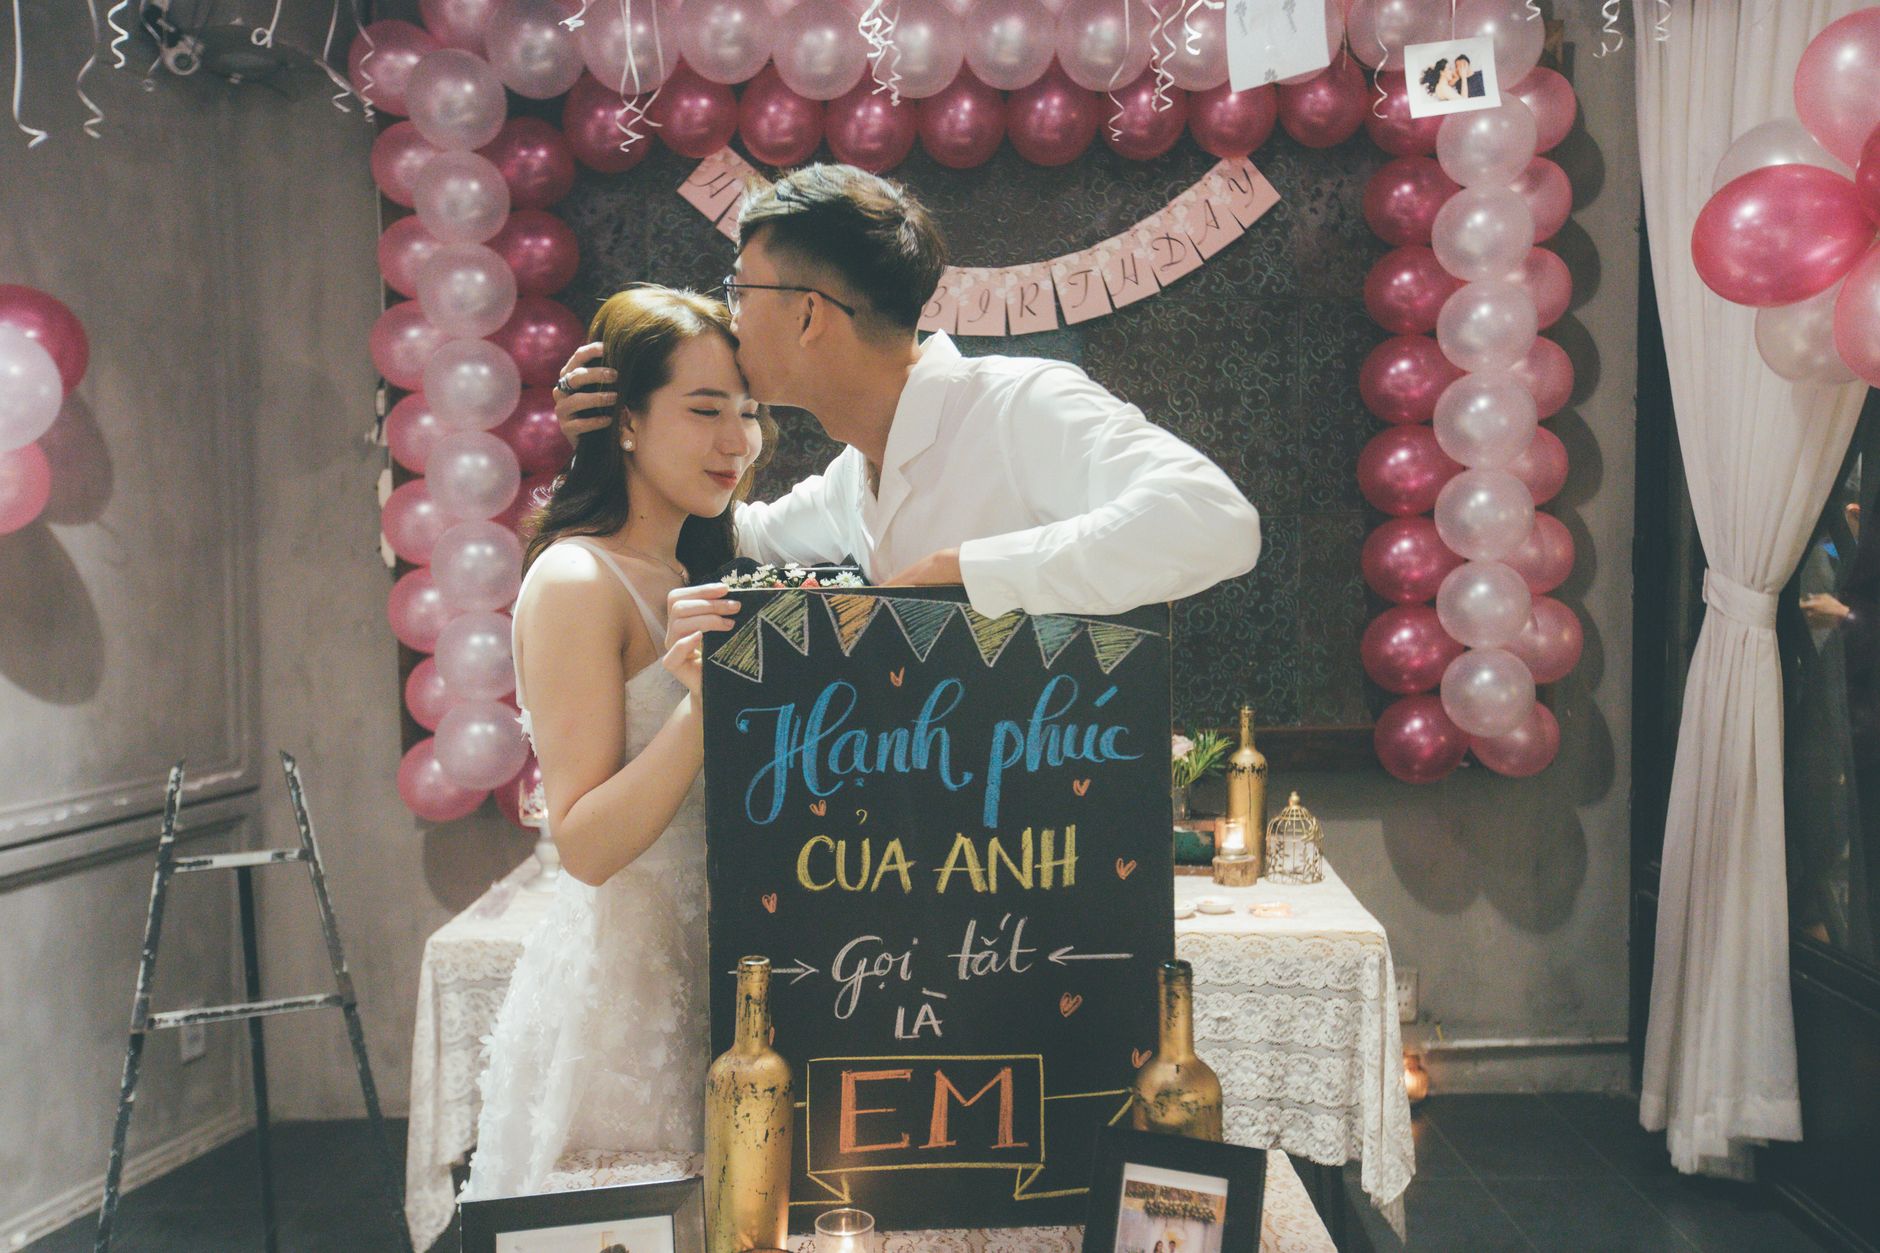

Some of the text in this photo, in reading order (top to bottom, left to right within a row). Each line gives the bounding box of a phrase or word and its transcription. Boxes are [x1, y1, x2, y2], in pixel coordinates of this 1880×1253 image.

[735, 673, 1145, 828] Hạnh phúc
[796, 808, 1080, 894] CỦA ANH
[947, 912, 1038, 980] tắt
[894, 986, 948, 1040] LÀ
[839, 1065, 1029, 1154] EM
